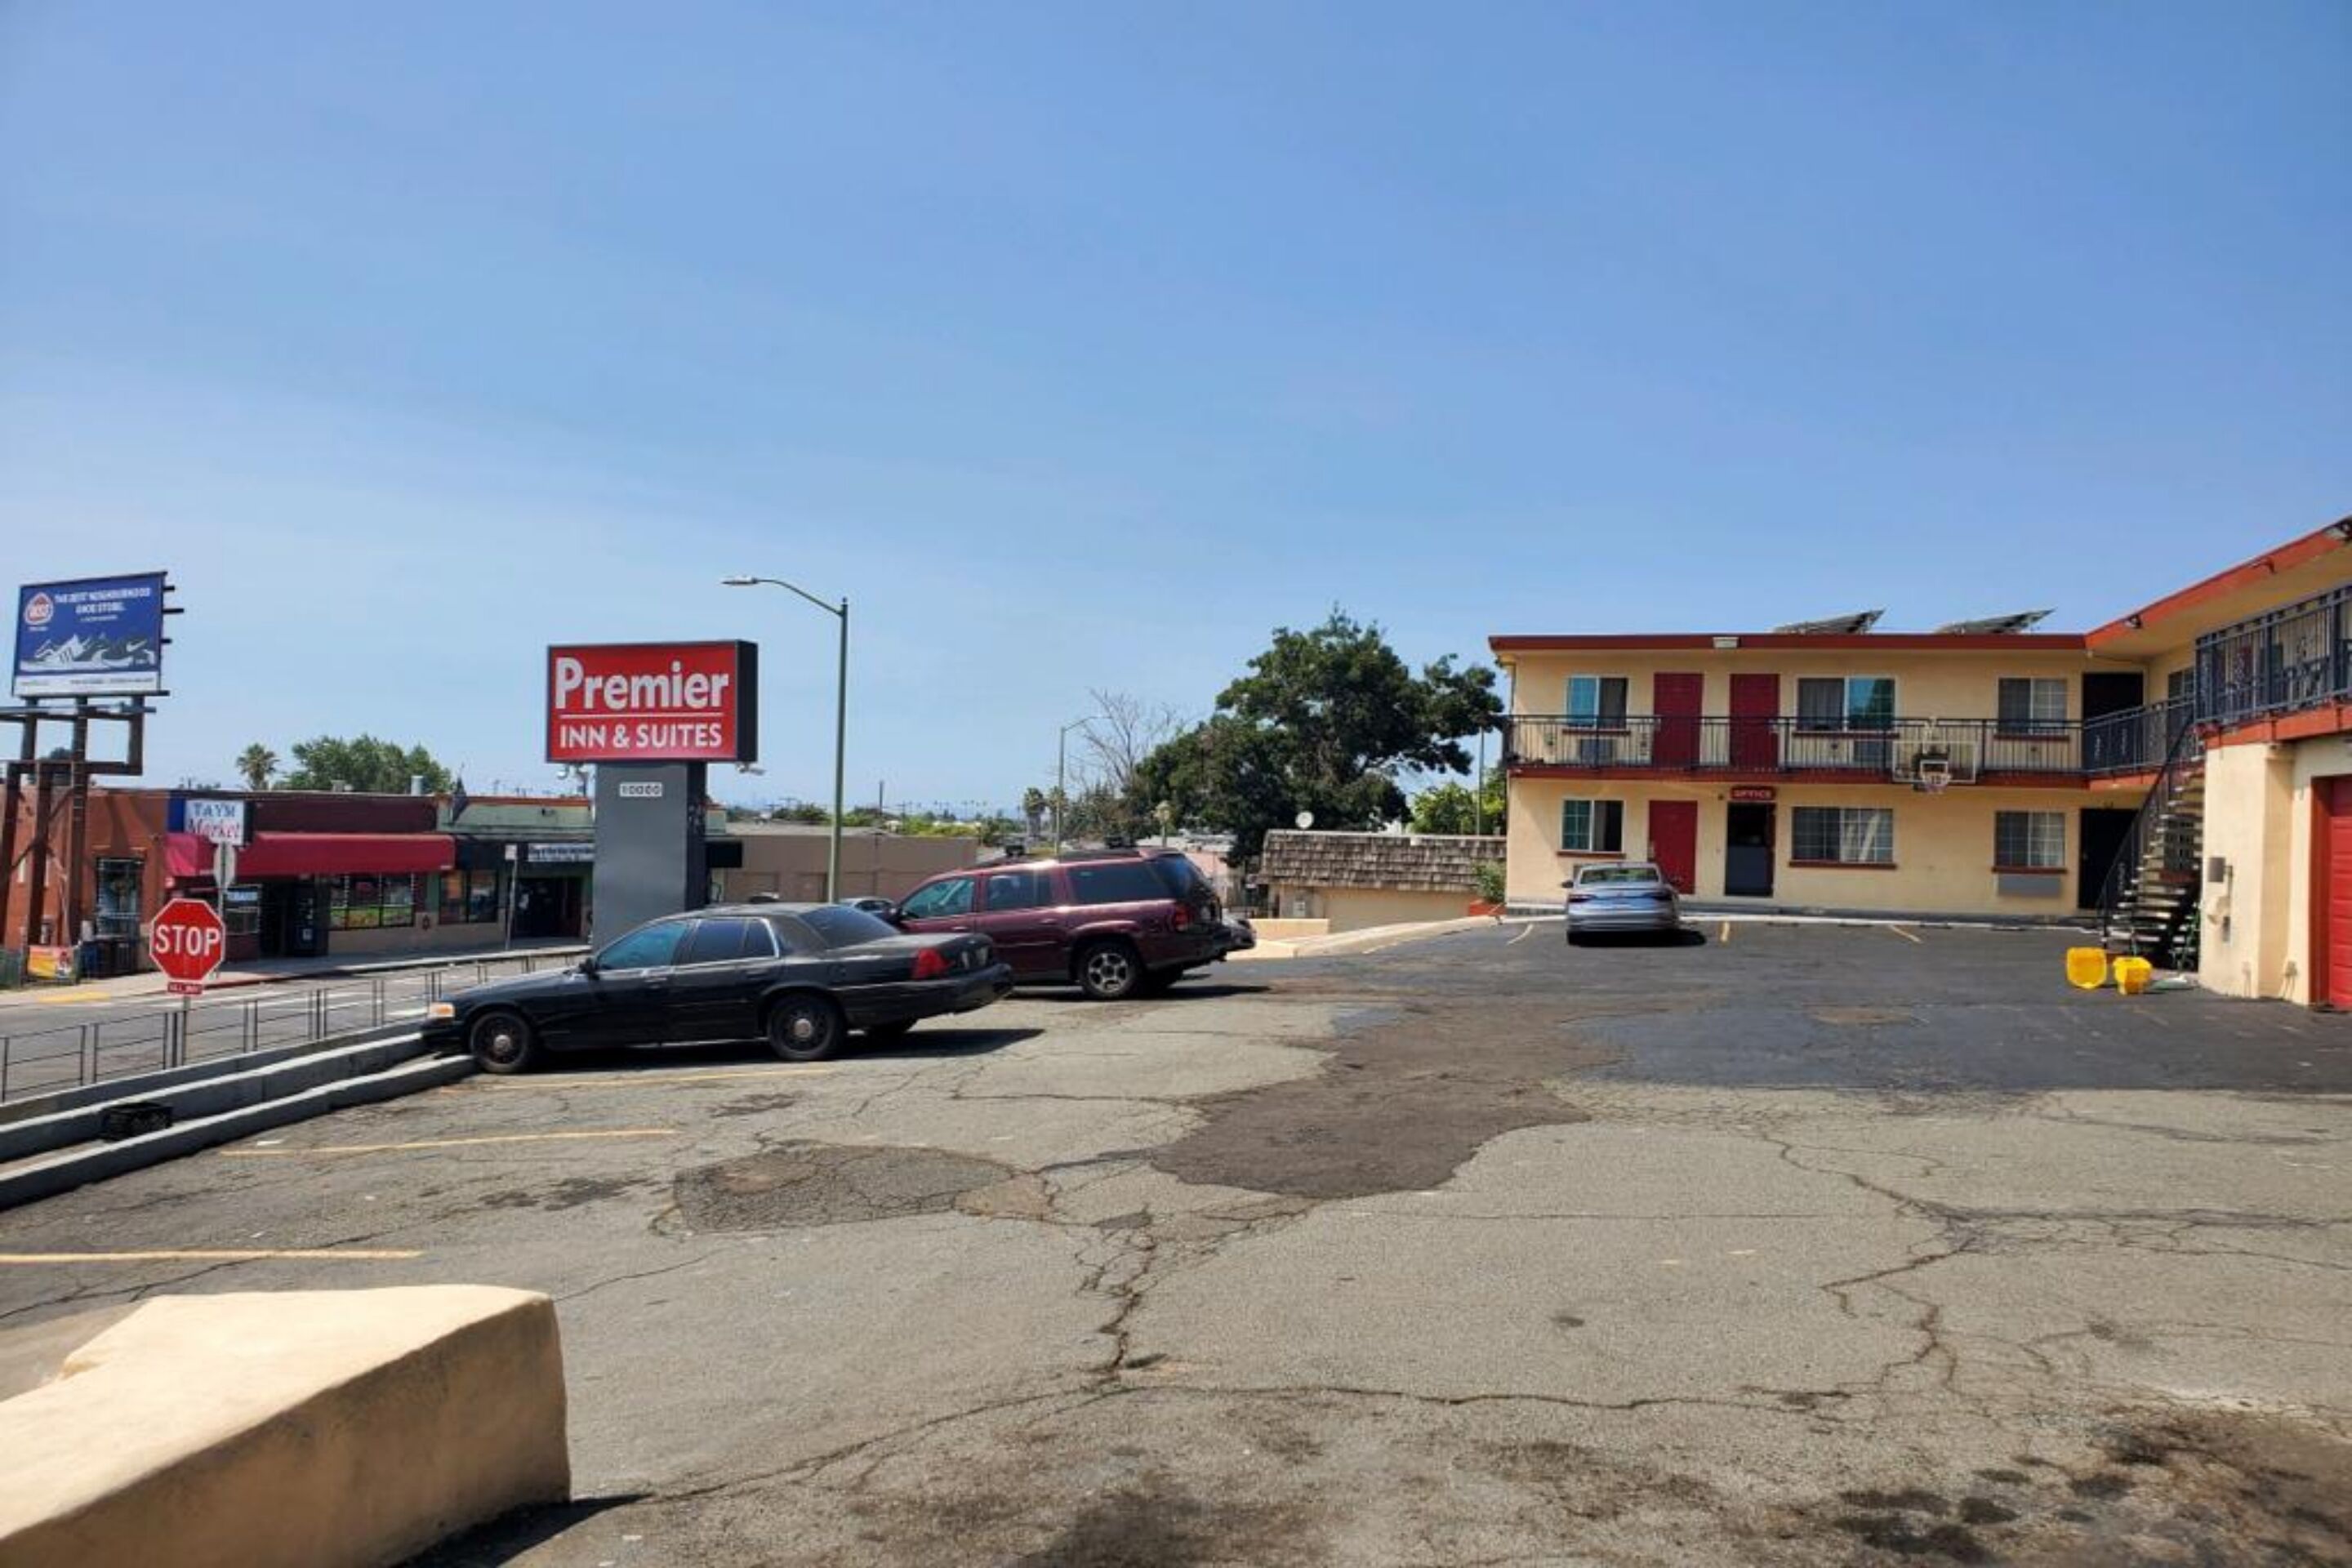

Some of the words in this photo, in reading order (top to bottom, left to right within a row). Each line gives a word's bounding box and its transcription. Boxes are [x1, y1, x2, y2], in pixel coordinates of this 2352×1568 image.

[555, 657, 729, 710] Premier
[560, 724, 607, 749] INN
[612, 724, 630, 748] &
[635, 723, 723, 748] SUITES
[155, 924, 220, 956] STOP
